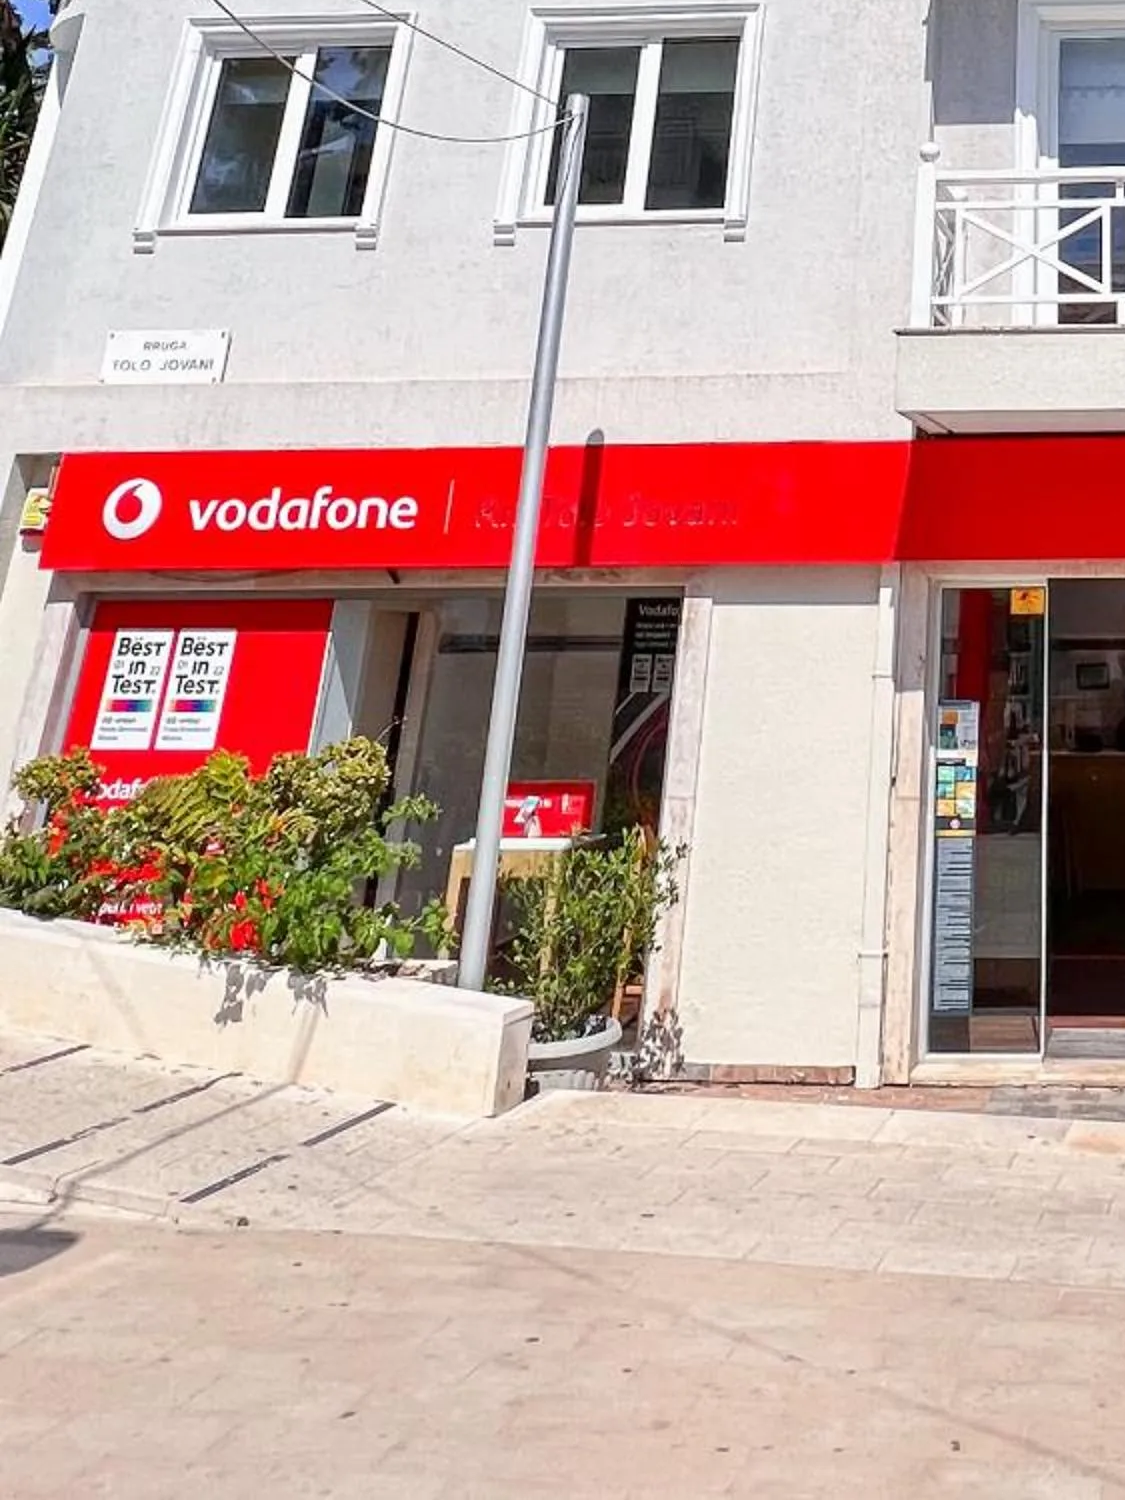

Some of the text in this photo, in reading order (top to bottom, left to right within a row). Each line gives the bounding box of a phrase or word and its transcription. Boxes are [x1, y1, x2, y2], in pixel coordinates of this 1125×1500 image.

[143, 341, 187, 351] RRUGA
[113, 358, 214, 372] TOLO JOVANI
[188, 485, 418, 531] vodafone
[639, 603, 679, 616] Vodafo
